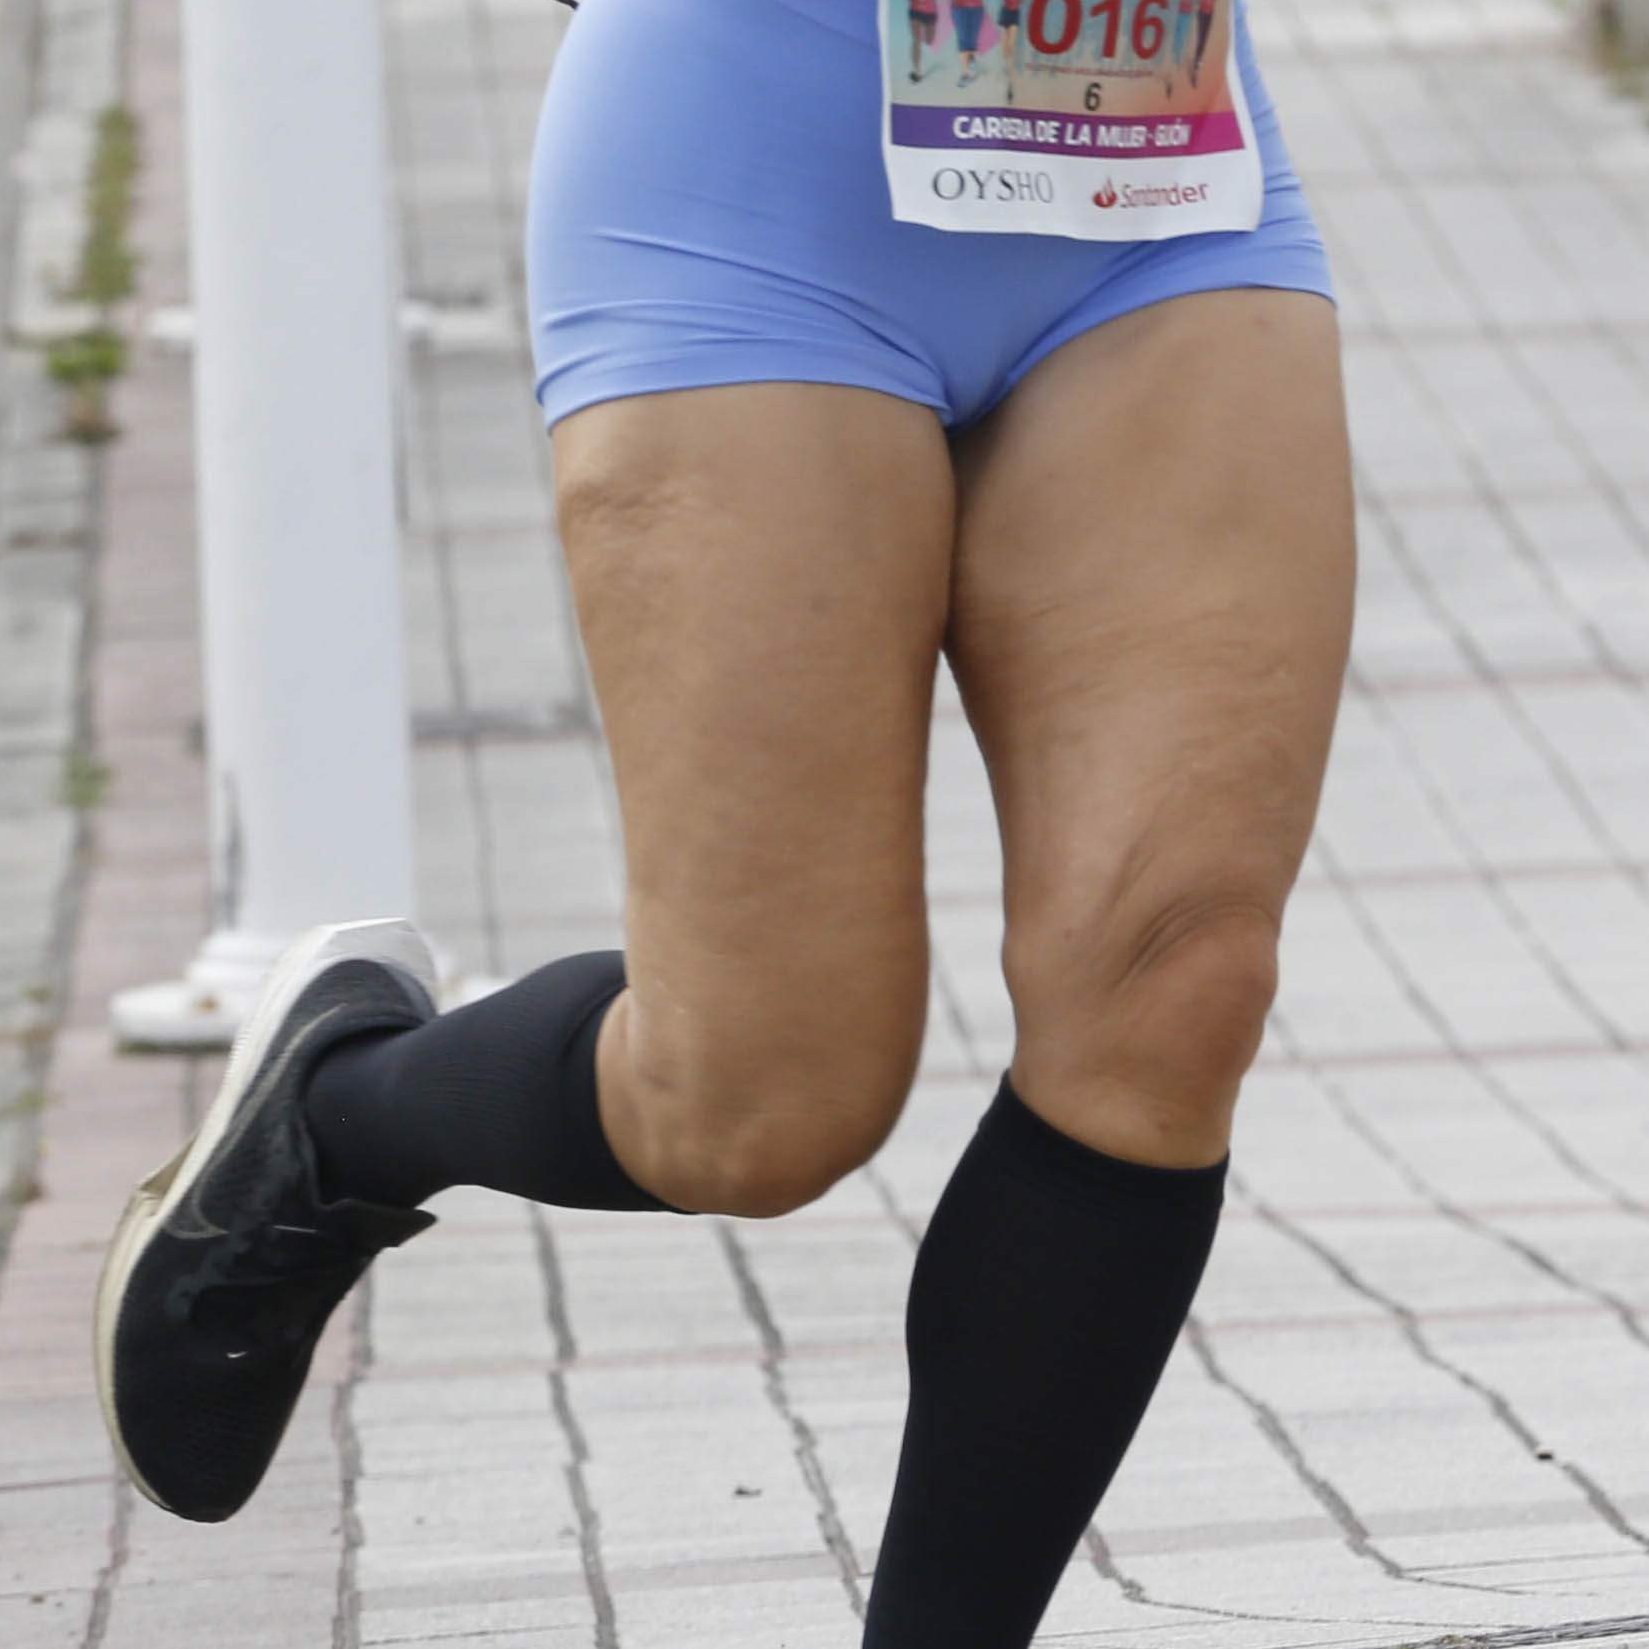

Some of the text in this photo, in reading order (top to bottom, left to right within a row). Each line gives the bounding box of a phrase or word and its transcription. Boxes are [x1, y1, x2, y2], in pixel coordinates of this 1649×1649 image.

[1084, 82, 1103, 112] 6
[1037, 122, 1061, 144] DE
[1064, 123, 1093, 147] LA
[931, 167, 1055, 204] OYSHO
